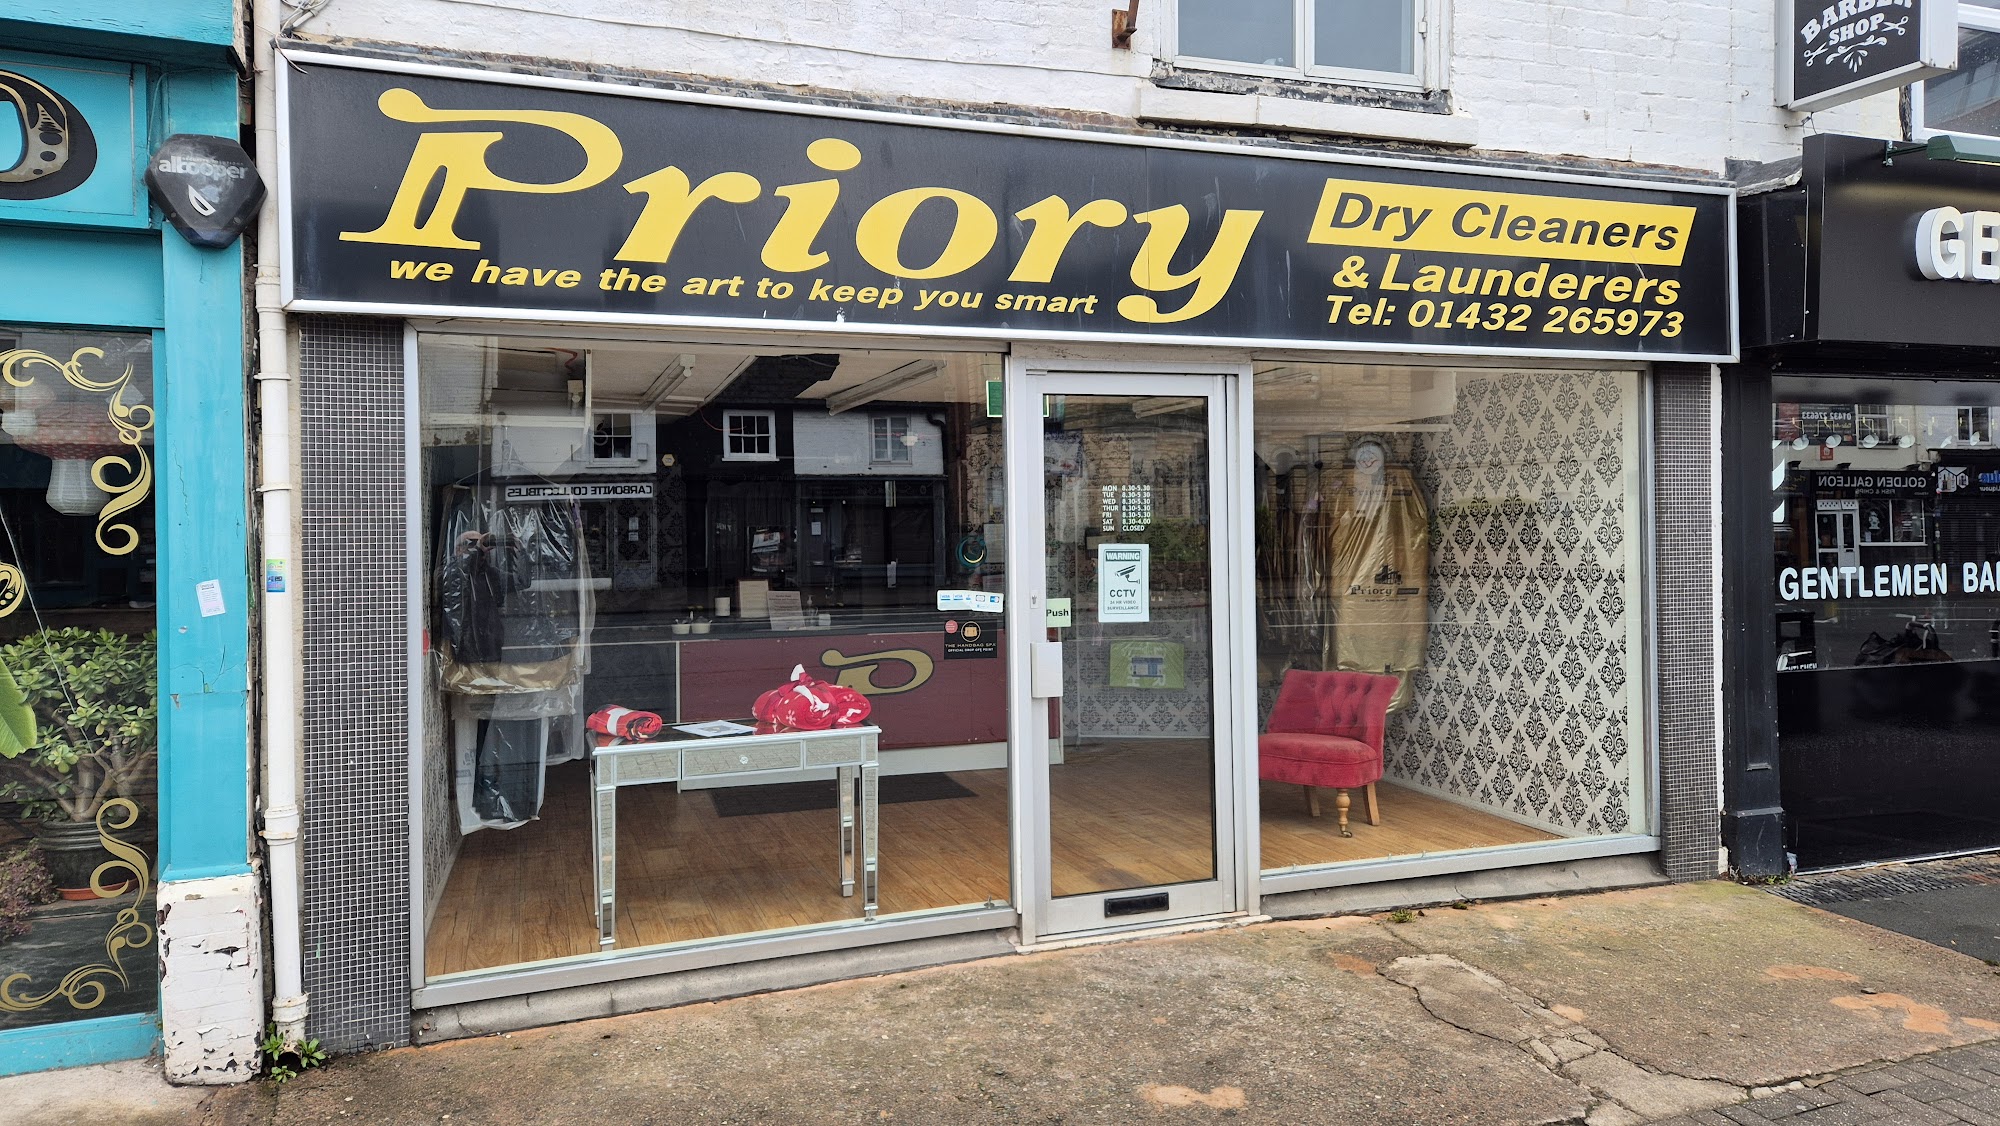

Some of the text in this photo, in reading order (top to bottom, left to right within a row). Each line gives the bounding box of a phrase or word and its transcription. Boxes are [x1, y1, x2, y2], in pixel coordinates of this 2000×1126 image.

[1829, 13, 1885, 46] SHOP
[340, 90, 1262, 324] Priory
[1329, 192, 1680, 251] Dry Cleaners
[390, 259, 1099, 315] we have the art to keep you smart
[1332, 254, 1681, 306] & Launderers
[1327, 296, 1685, 338] Tel: 01432 265973
[1106, 552, 1140, 560] WARNING
[1109, 589, 1136, 598] CCTV
[1779, 560, 2000, 600] GENTLEMEN BA
[1046, 609, 1069, 617] Push
